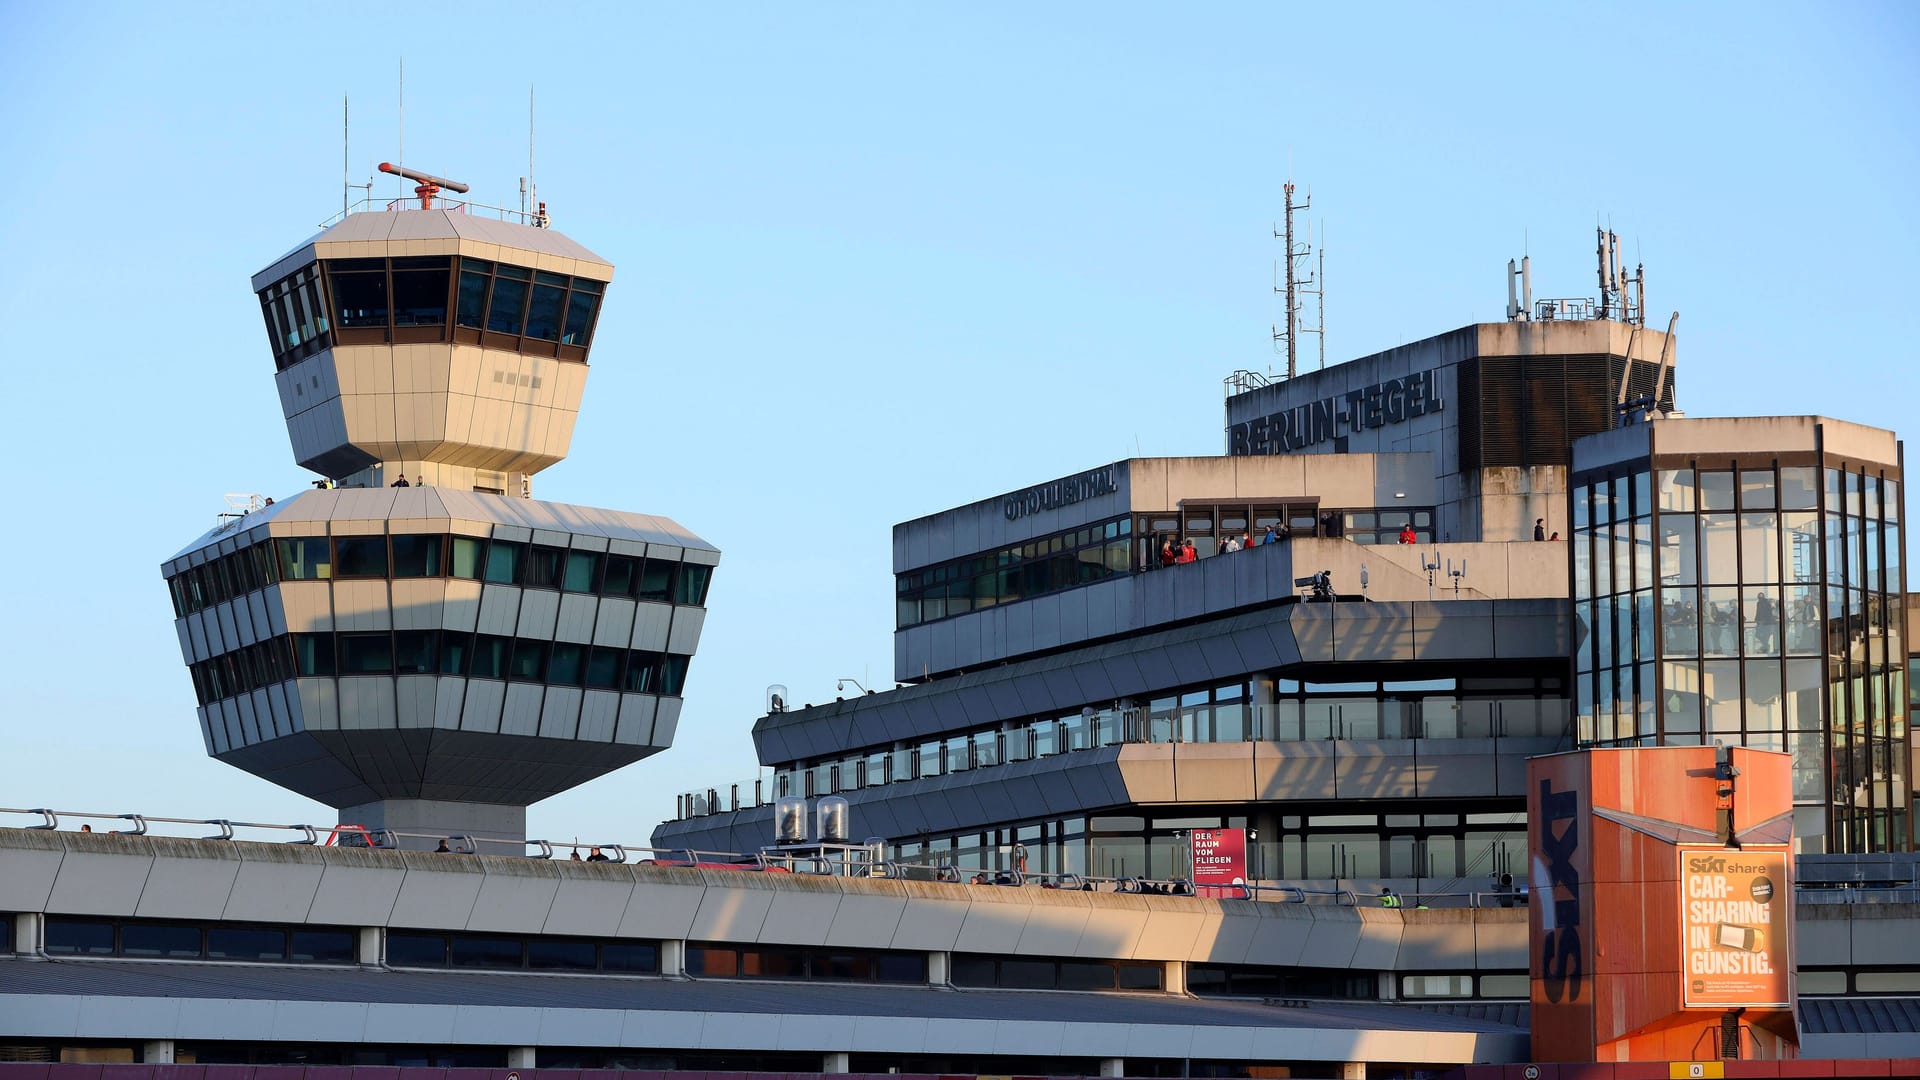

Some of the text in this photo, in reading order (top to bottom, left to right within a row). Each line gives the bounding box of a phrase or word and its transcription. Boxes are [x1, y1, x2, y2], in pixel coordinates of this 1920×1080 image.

[1231, 369, 1444, 455] BERLIN-TEGEL
[1005, 469, 1118, 521] OTTO LILIENTHAL
[1728, 863, 1766, 874] share
[1689, 875, 1734, 898] CAR-
[1690, 900, 1770, 924] SHARING
[1690, 926, 1710, 949] IN
[1691, 948, 1773, 975] GÜNSTIG.
